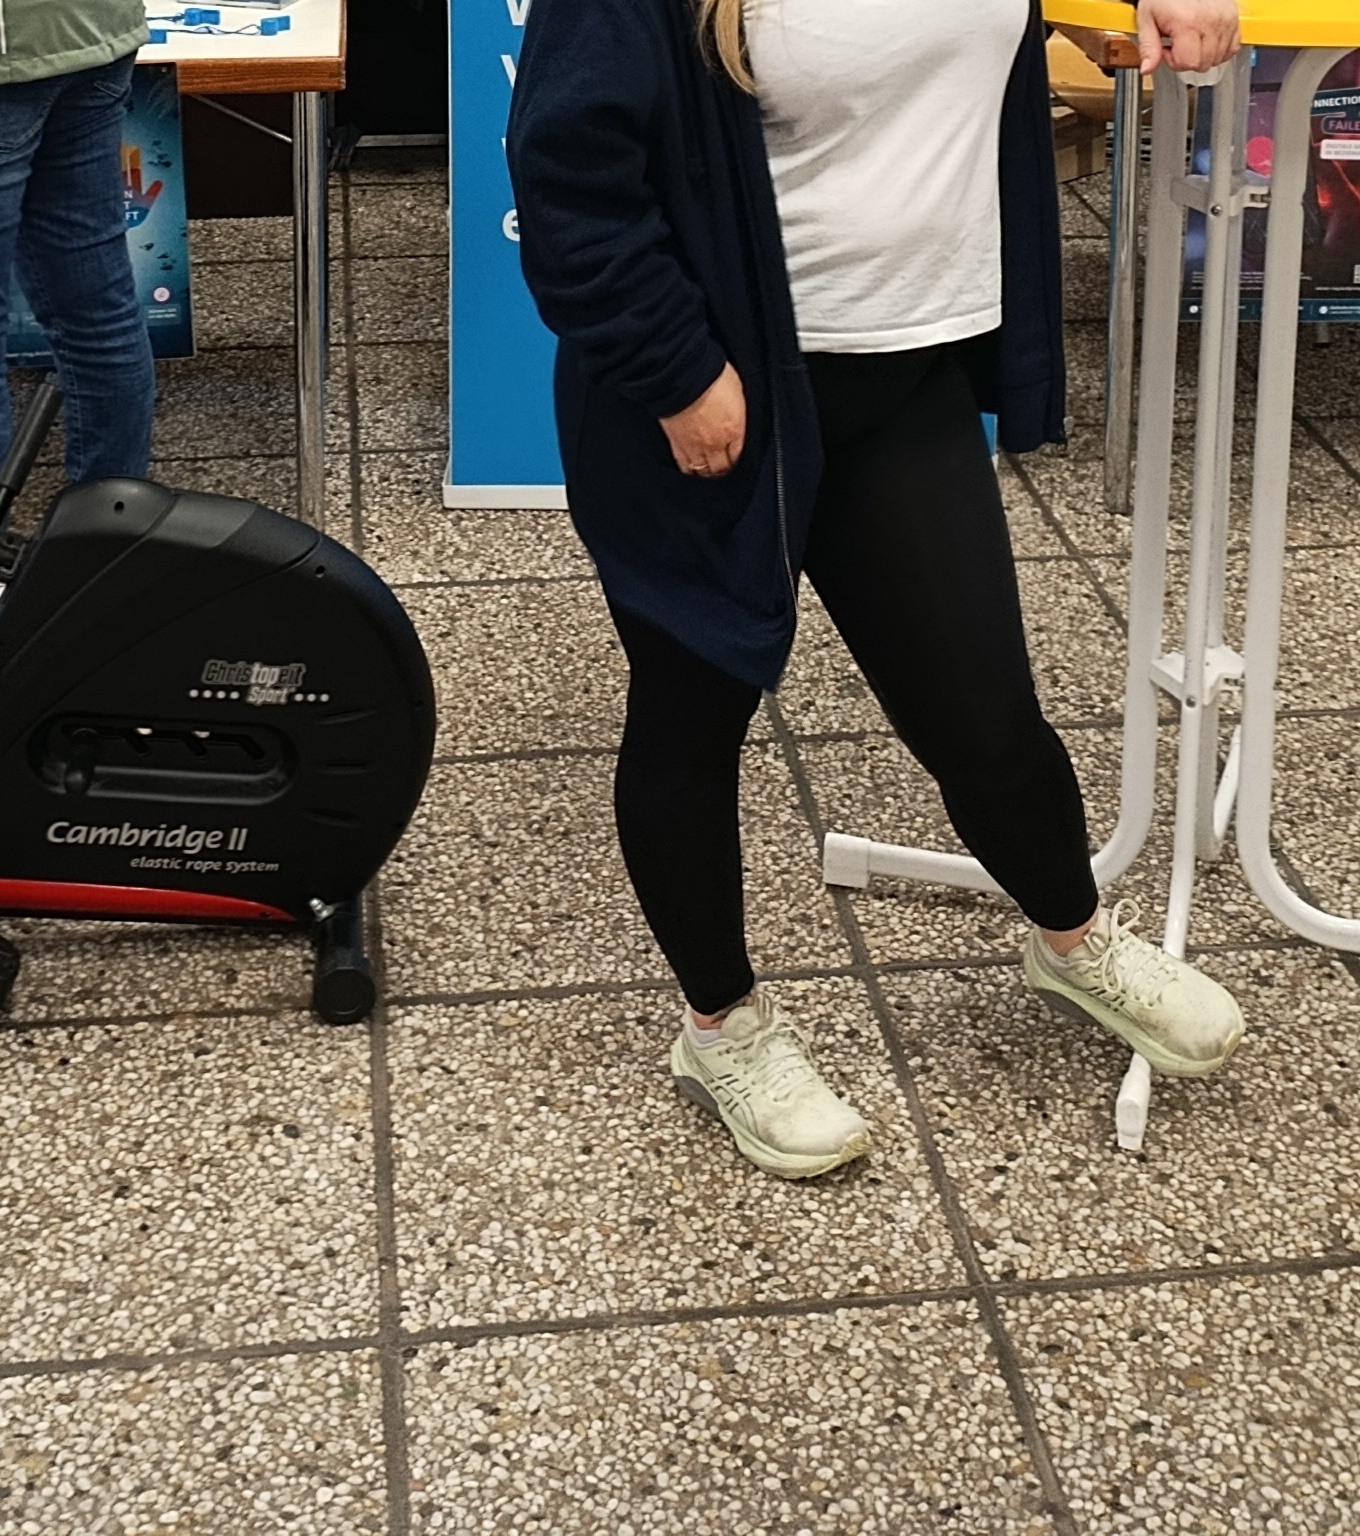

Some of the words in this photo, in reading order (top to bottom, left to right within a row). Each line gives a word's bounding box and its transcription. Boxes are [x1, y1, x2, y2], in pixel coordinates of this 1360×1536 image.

[202, 659, 306, 688] Christopeit
[247, 685, 289, 706] Sport
[45, 821, 224, 855] Cambridge
[228, 827, 249, 852] II
[130, 856, 182, 871] elastic
[185, 860, 223, 874] rope
[225, 859, 280, 875] system
